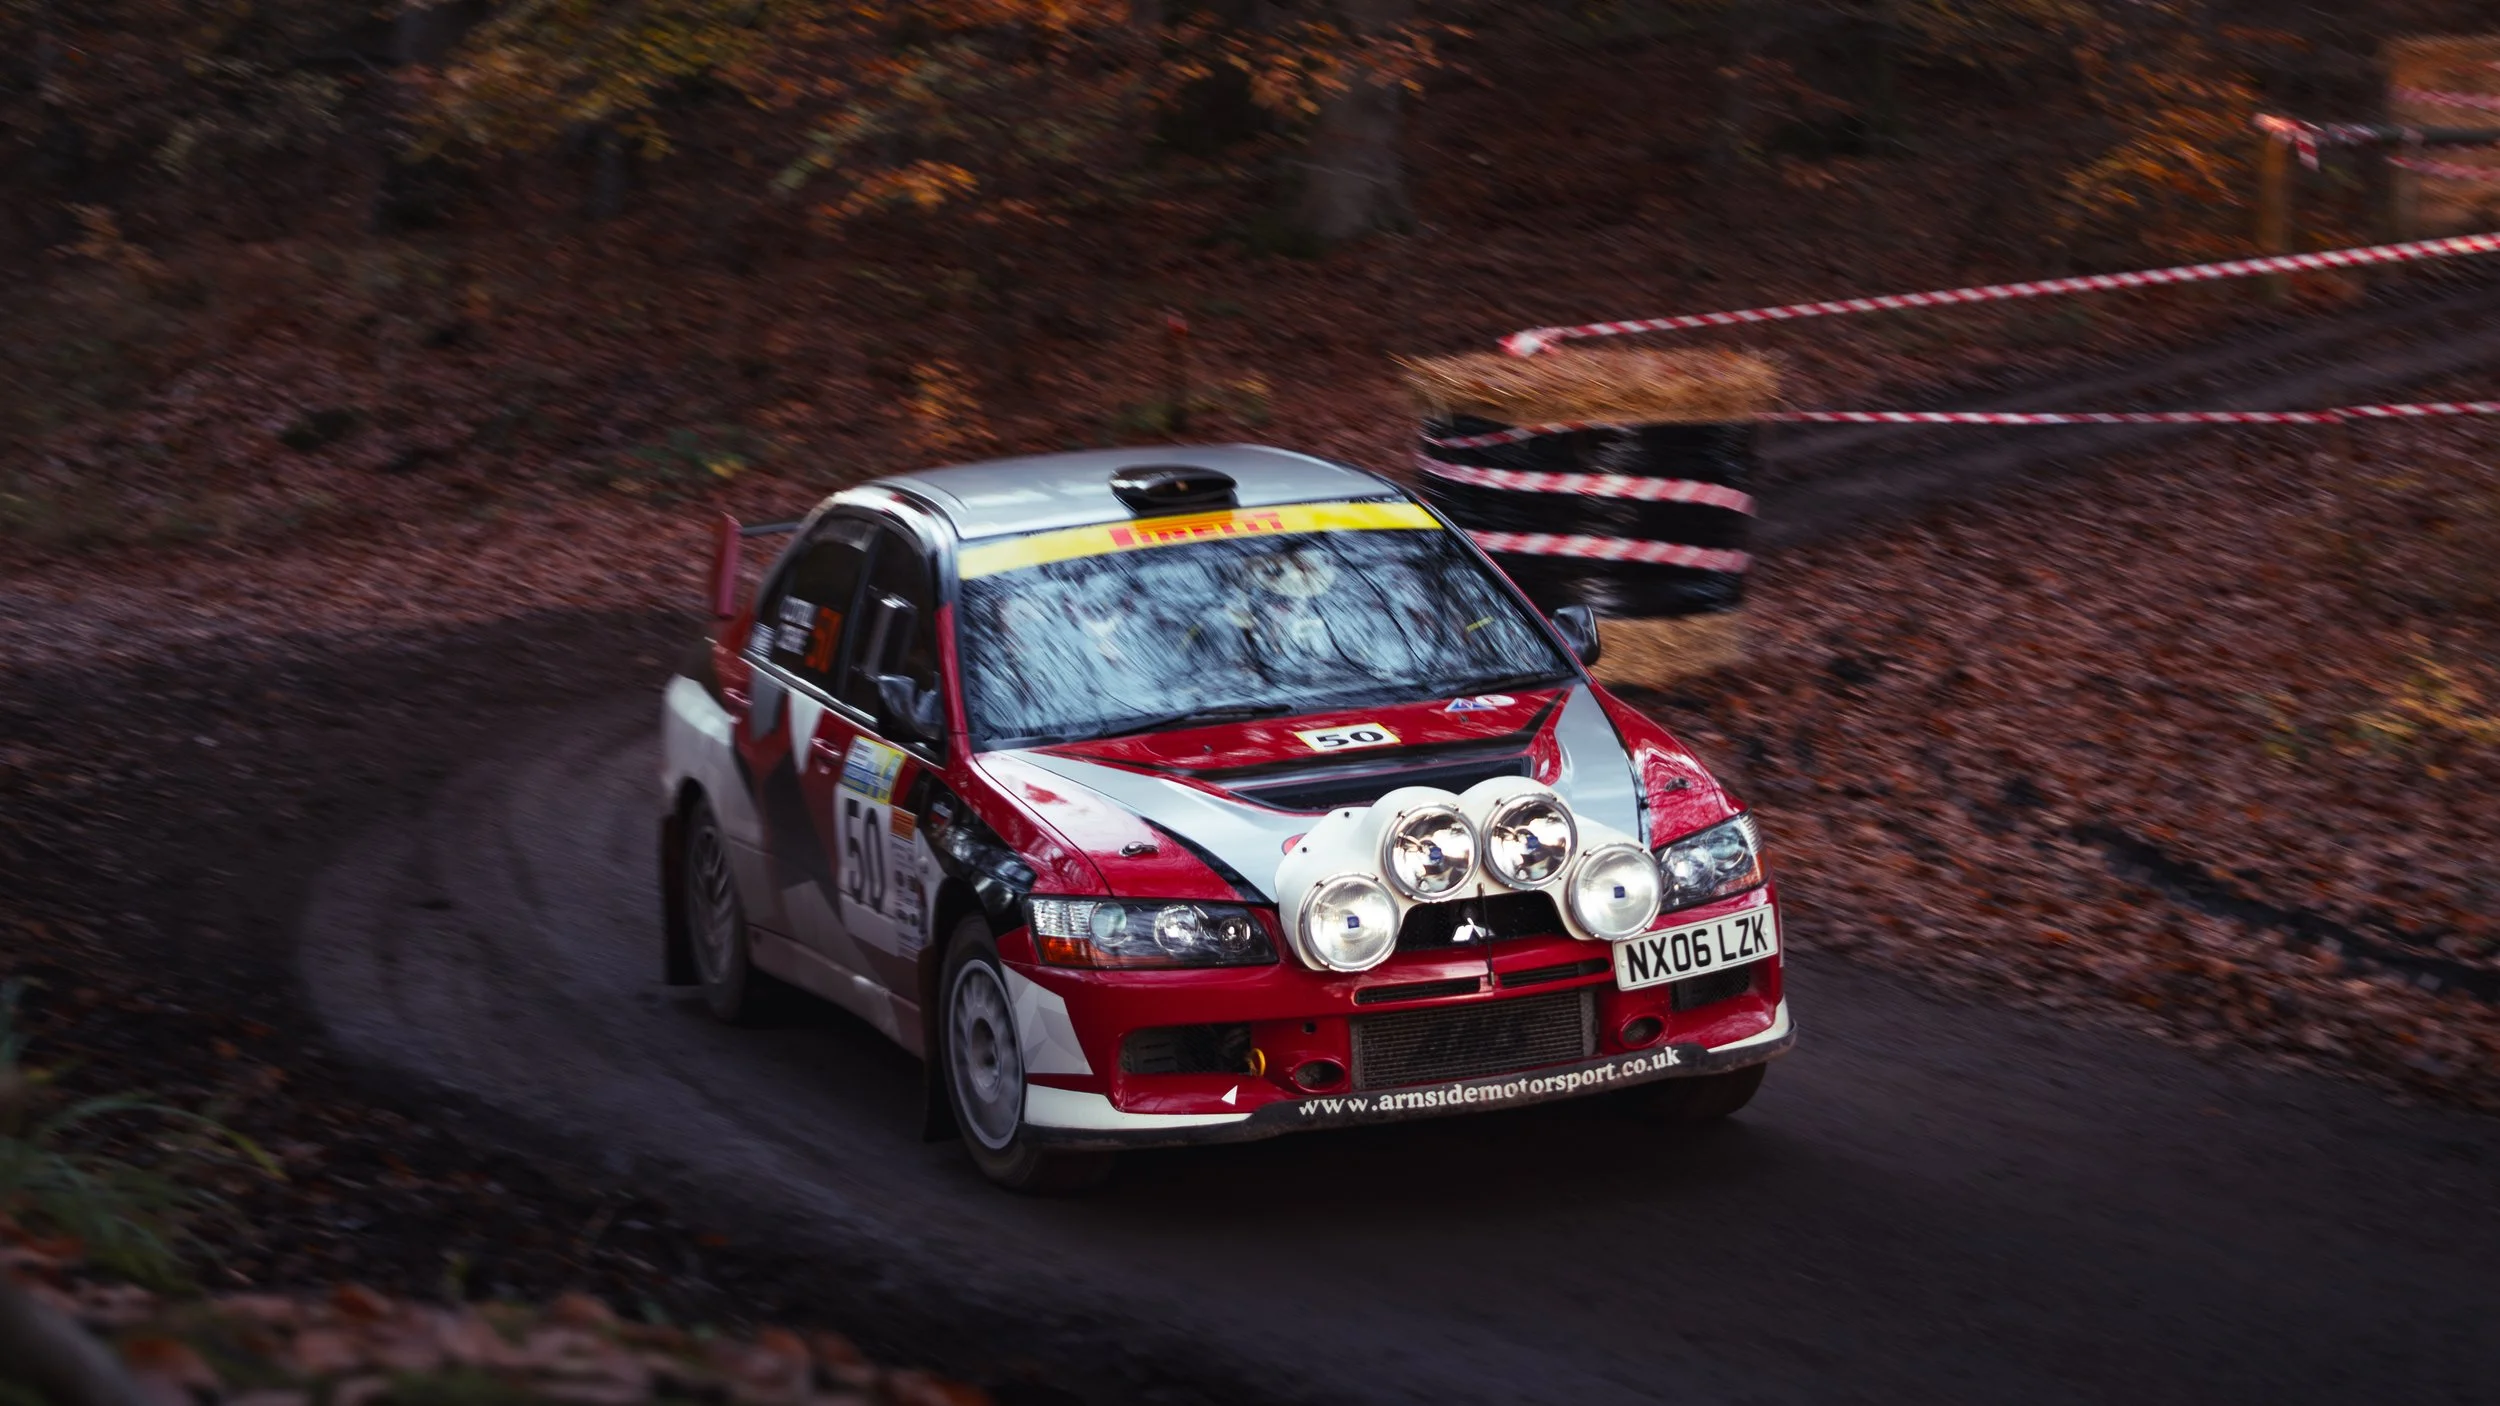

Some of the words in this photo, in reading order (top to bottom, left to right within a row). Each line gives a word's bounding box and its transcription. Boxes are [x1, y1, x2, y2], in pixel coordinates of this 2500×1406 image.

[1316, 730, 1385, 748] 50
[844, 797, 886, 915] 50
[1625, 928, 1712, 983] NX06
[1717, 913, 1768, 962] LZK
[1298, 1045, 1682, 1116] www.arnsidemotorsport.co.uk
